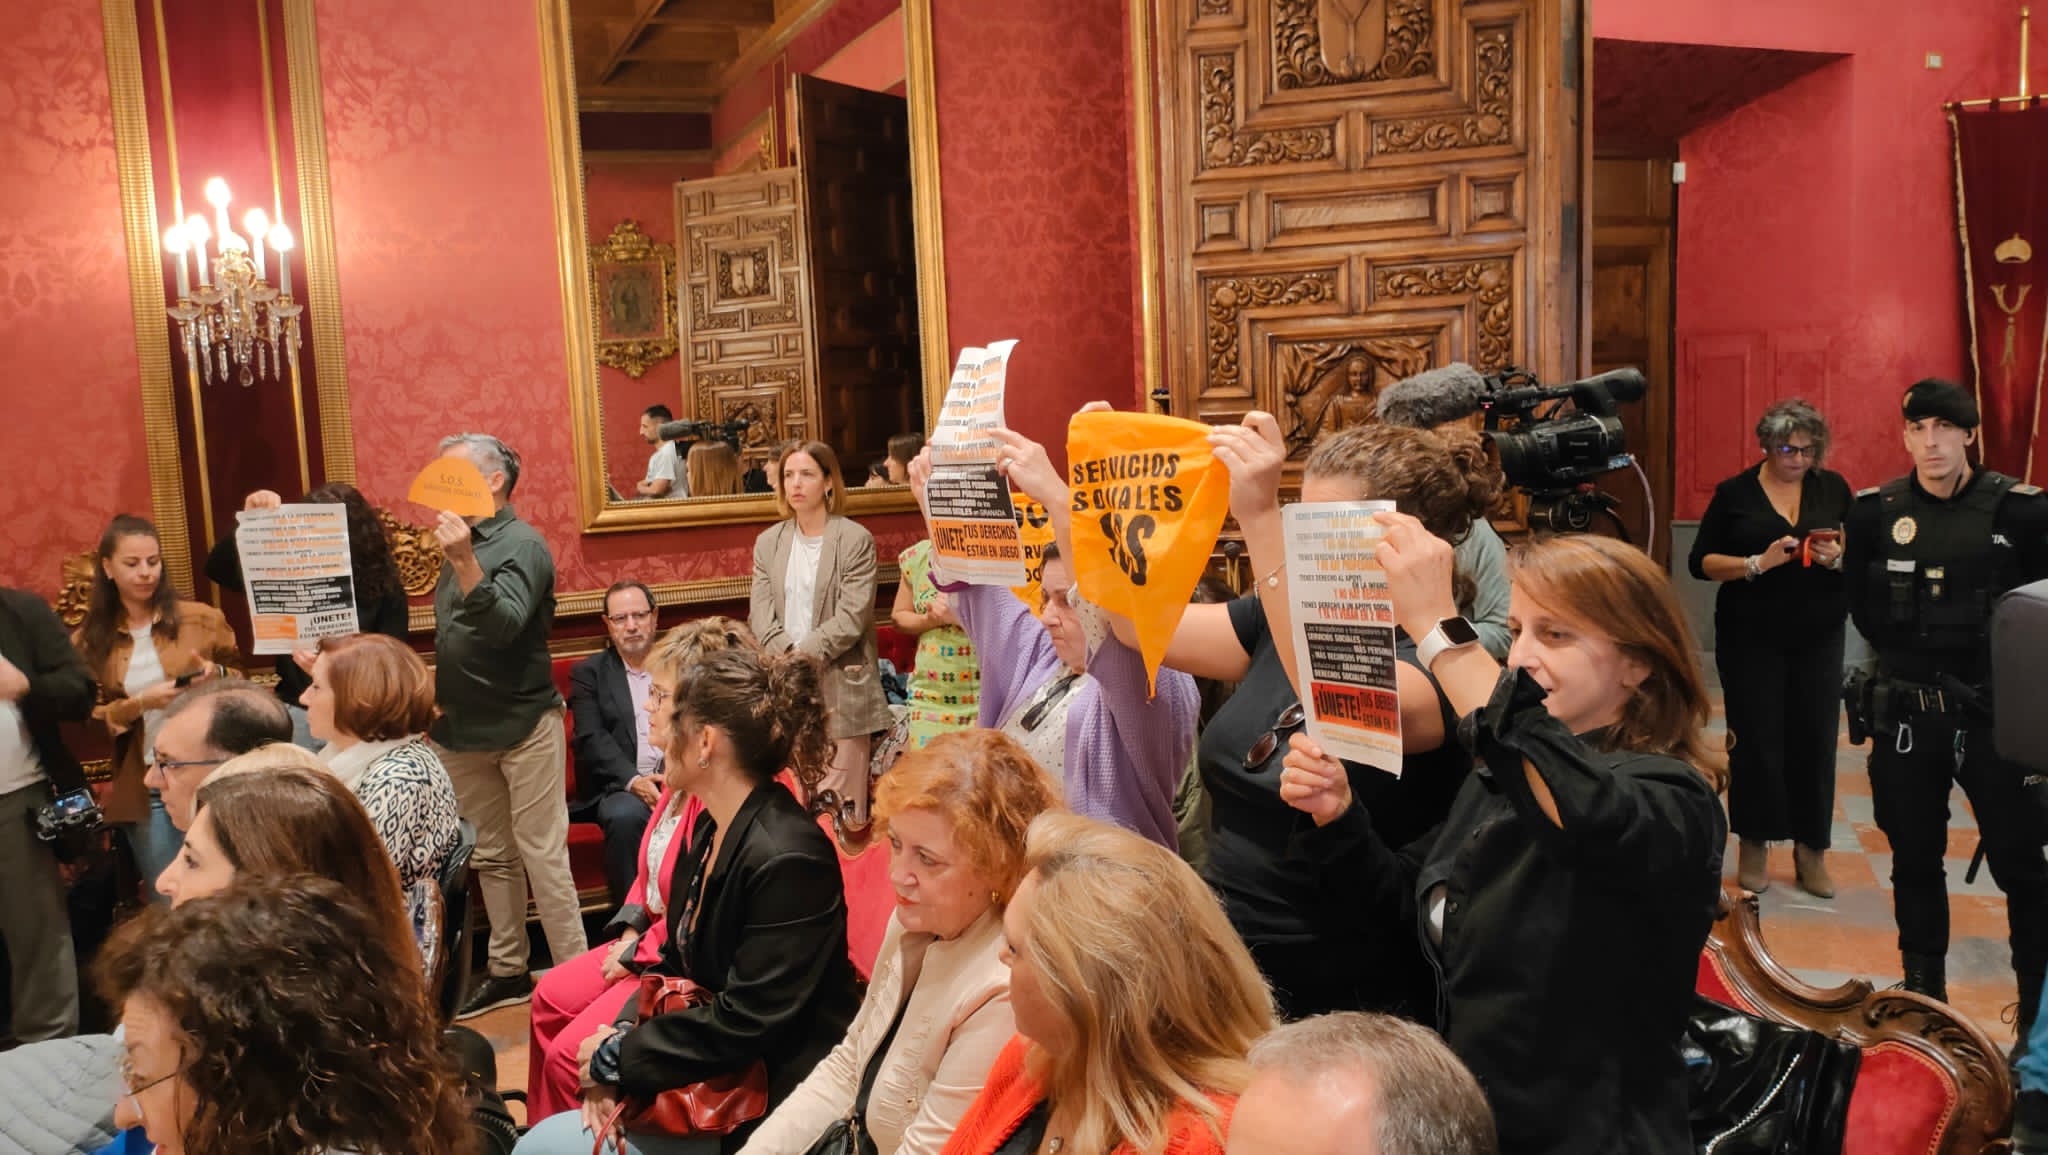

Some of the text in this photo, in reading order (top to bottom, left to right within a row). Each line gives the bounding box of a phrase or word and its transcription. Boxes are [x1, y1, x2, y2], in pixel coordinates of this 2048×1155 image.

[1073, 453, 1181, 485] SERVICIOS
[963, 524, 1017, 541] TUS DERECHOS
[989, 546, 998, 558] EN
[999, 545, 1020, 559] JUEGO
[310, 611, 352, 627] ¡ÚNETE!
[1307, 633, 1334, 642] SERVICIOS
[1335, 634, 1361, 643] SOCIALES
[1327, 653, 1355, 662] RECURSOS
[1314, 669, 1341, 679] DERECHOS
[1342, 671, 1368, 682] SOCIALES
[1316, 683, 1362, 721] ¡ÚNETE!
